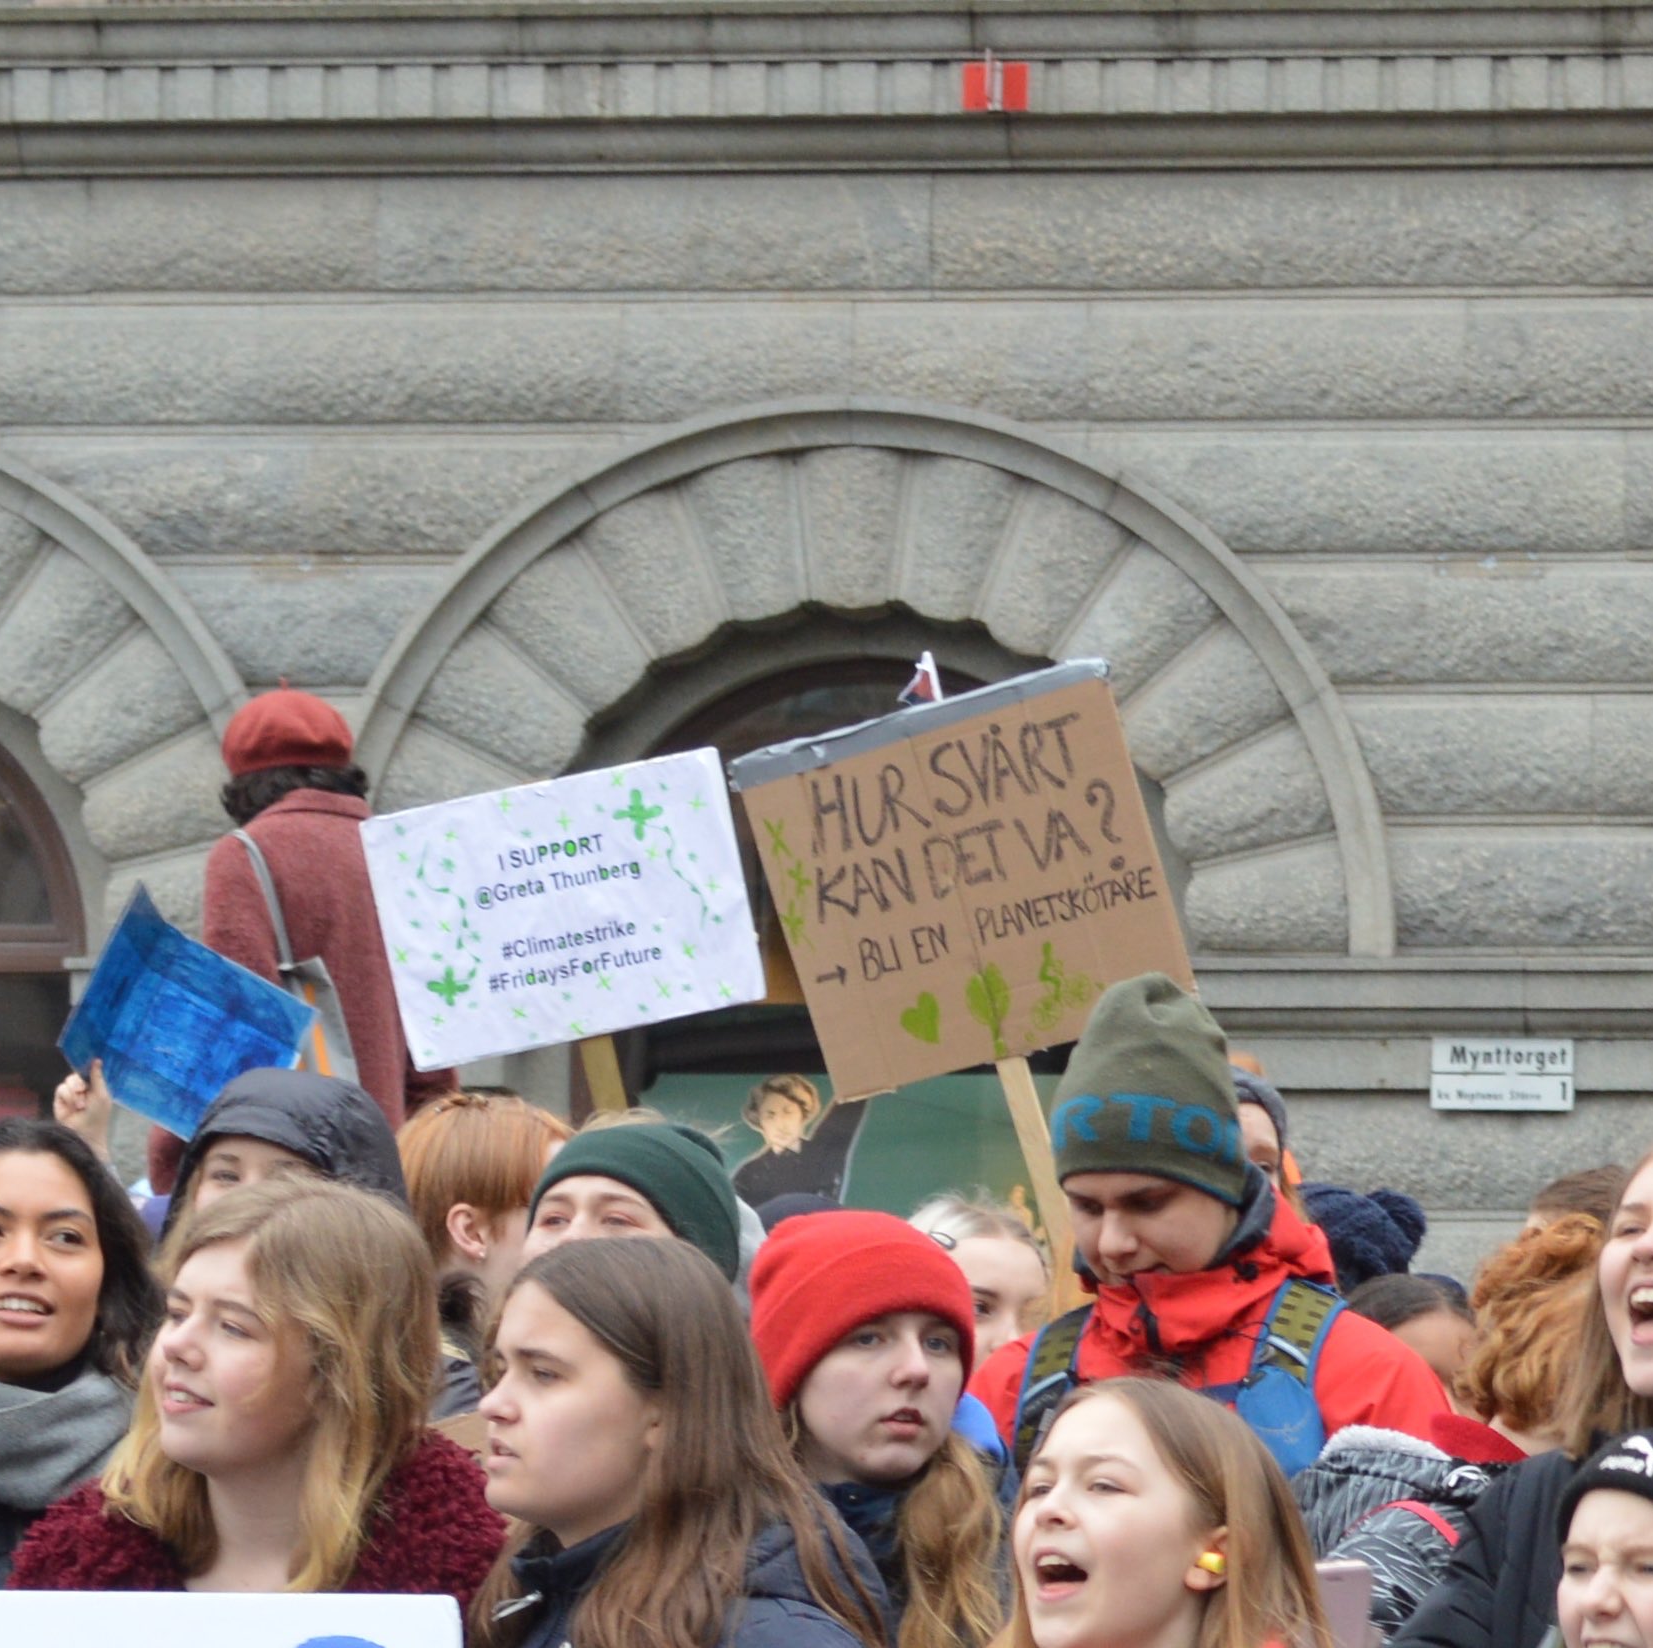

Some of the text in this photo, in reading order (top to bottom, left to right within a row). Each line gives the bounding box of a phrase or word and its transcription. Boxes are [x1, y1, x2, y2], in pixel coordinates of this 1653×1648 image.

[810, 711, 1081, 857] HUR SVÅRT
[497, 833, 604, 872] I SUPPORT
[815, 848, 917, 924] KAN
[921, 818, 1007, 900] DET
[475, 861, 643, 910] @Greta Thunberg
[502, 920, 637, 961] #Climatestrike
[858, 866, 1158, 982] BLI EN PLANETSKÖTARE
[488, 946, 663, 993] #FridaysForFuture
[1449, 1044, 1568, 1071] Mynttorget
[1051, 1093, 1242, 1163] RTO
